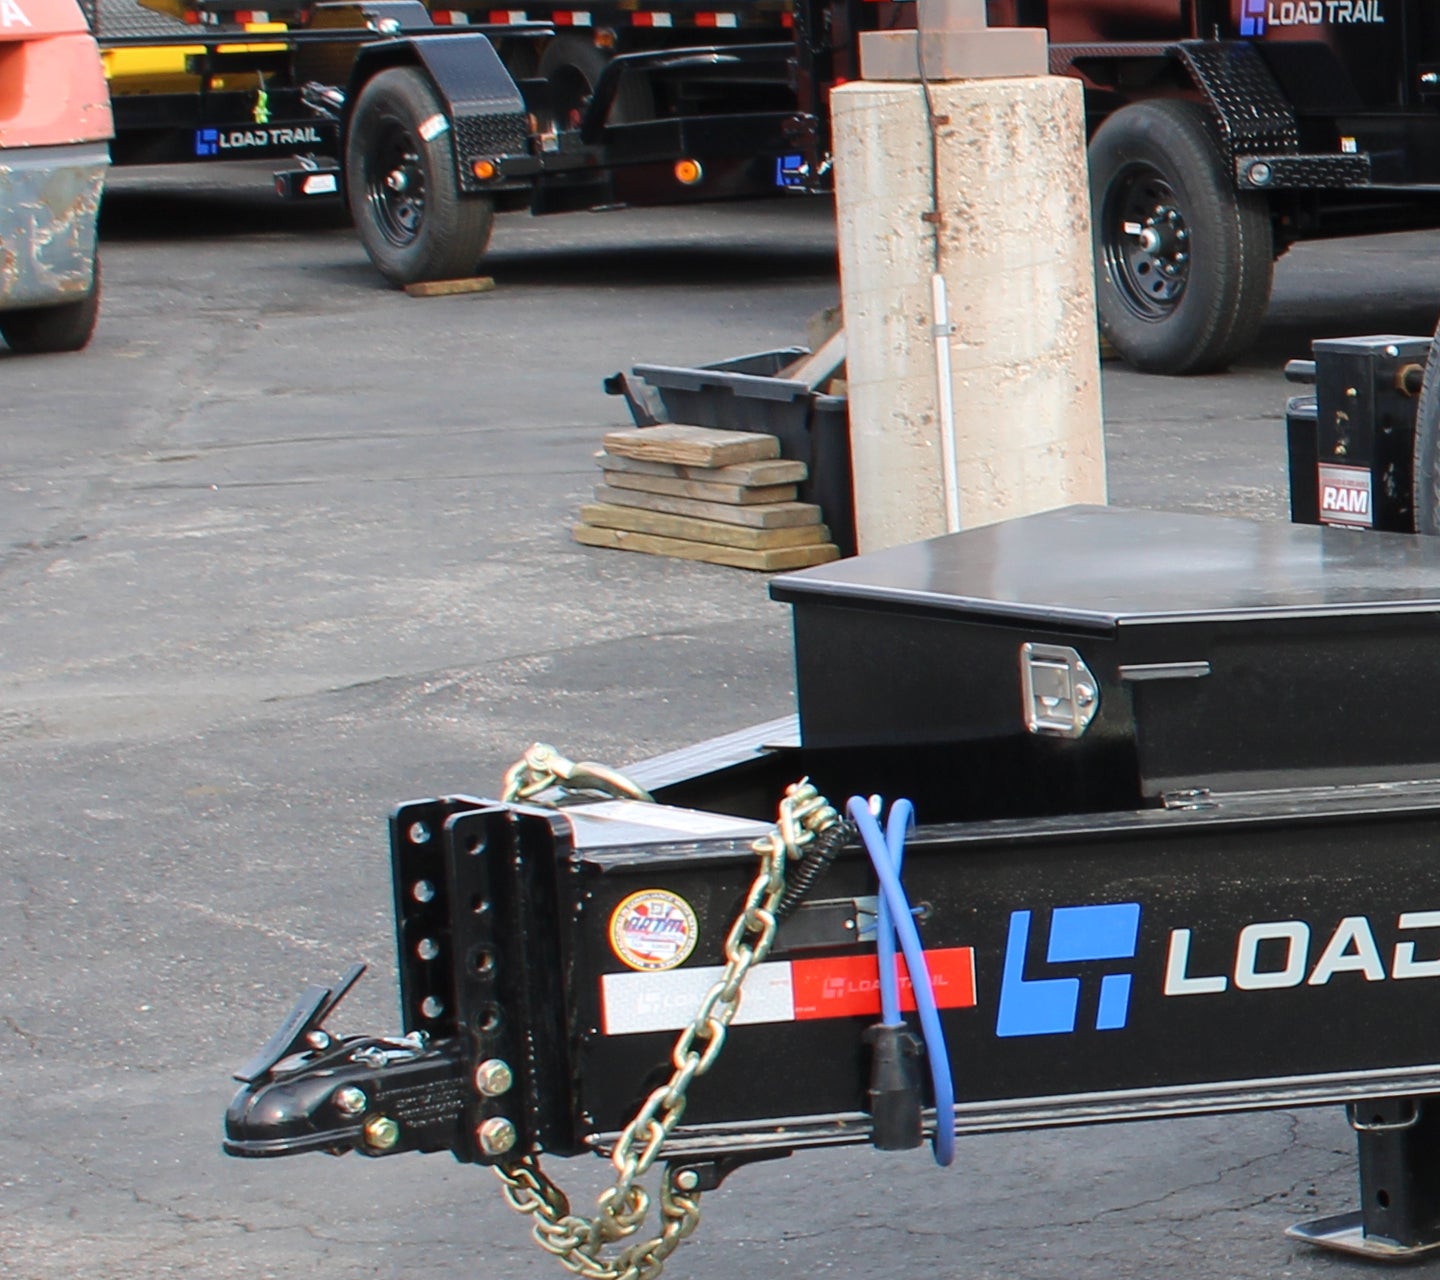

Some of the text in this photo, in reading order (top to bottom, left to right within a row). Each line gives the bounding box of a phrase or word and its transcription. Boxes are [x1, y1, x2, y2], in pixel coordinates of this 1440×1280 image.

[1267, 0, 1323, 26] LOAD
[219, 127, 322, 149] LOAD TRAIL
[1322, 485, 1369, 513] RAM
[847, 974, 949, 993] LOA TIL
